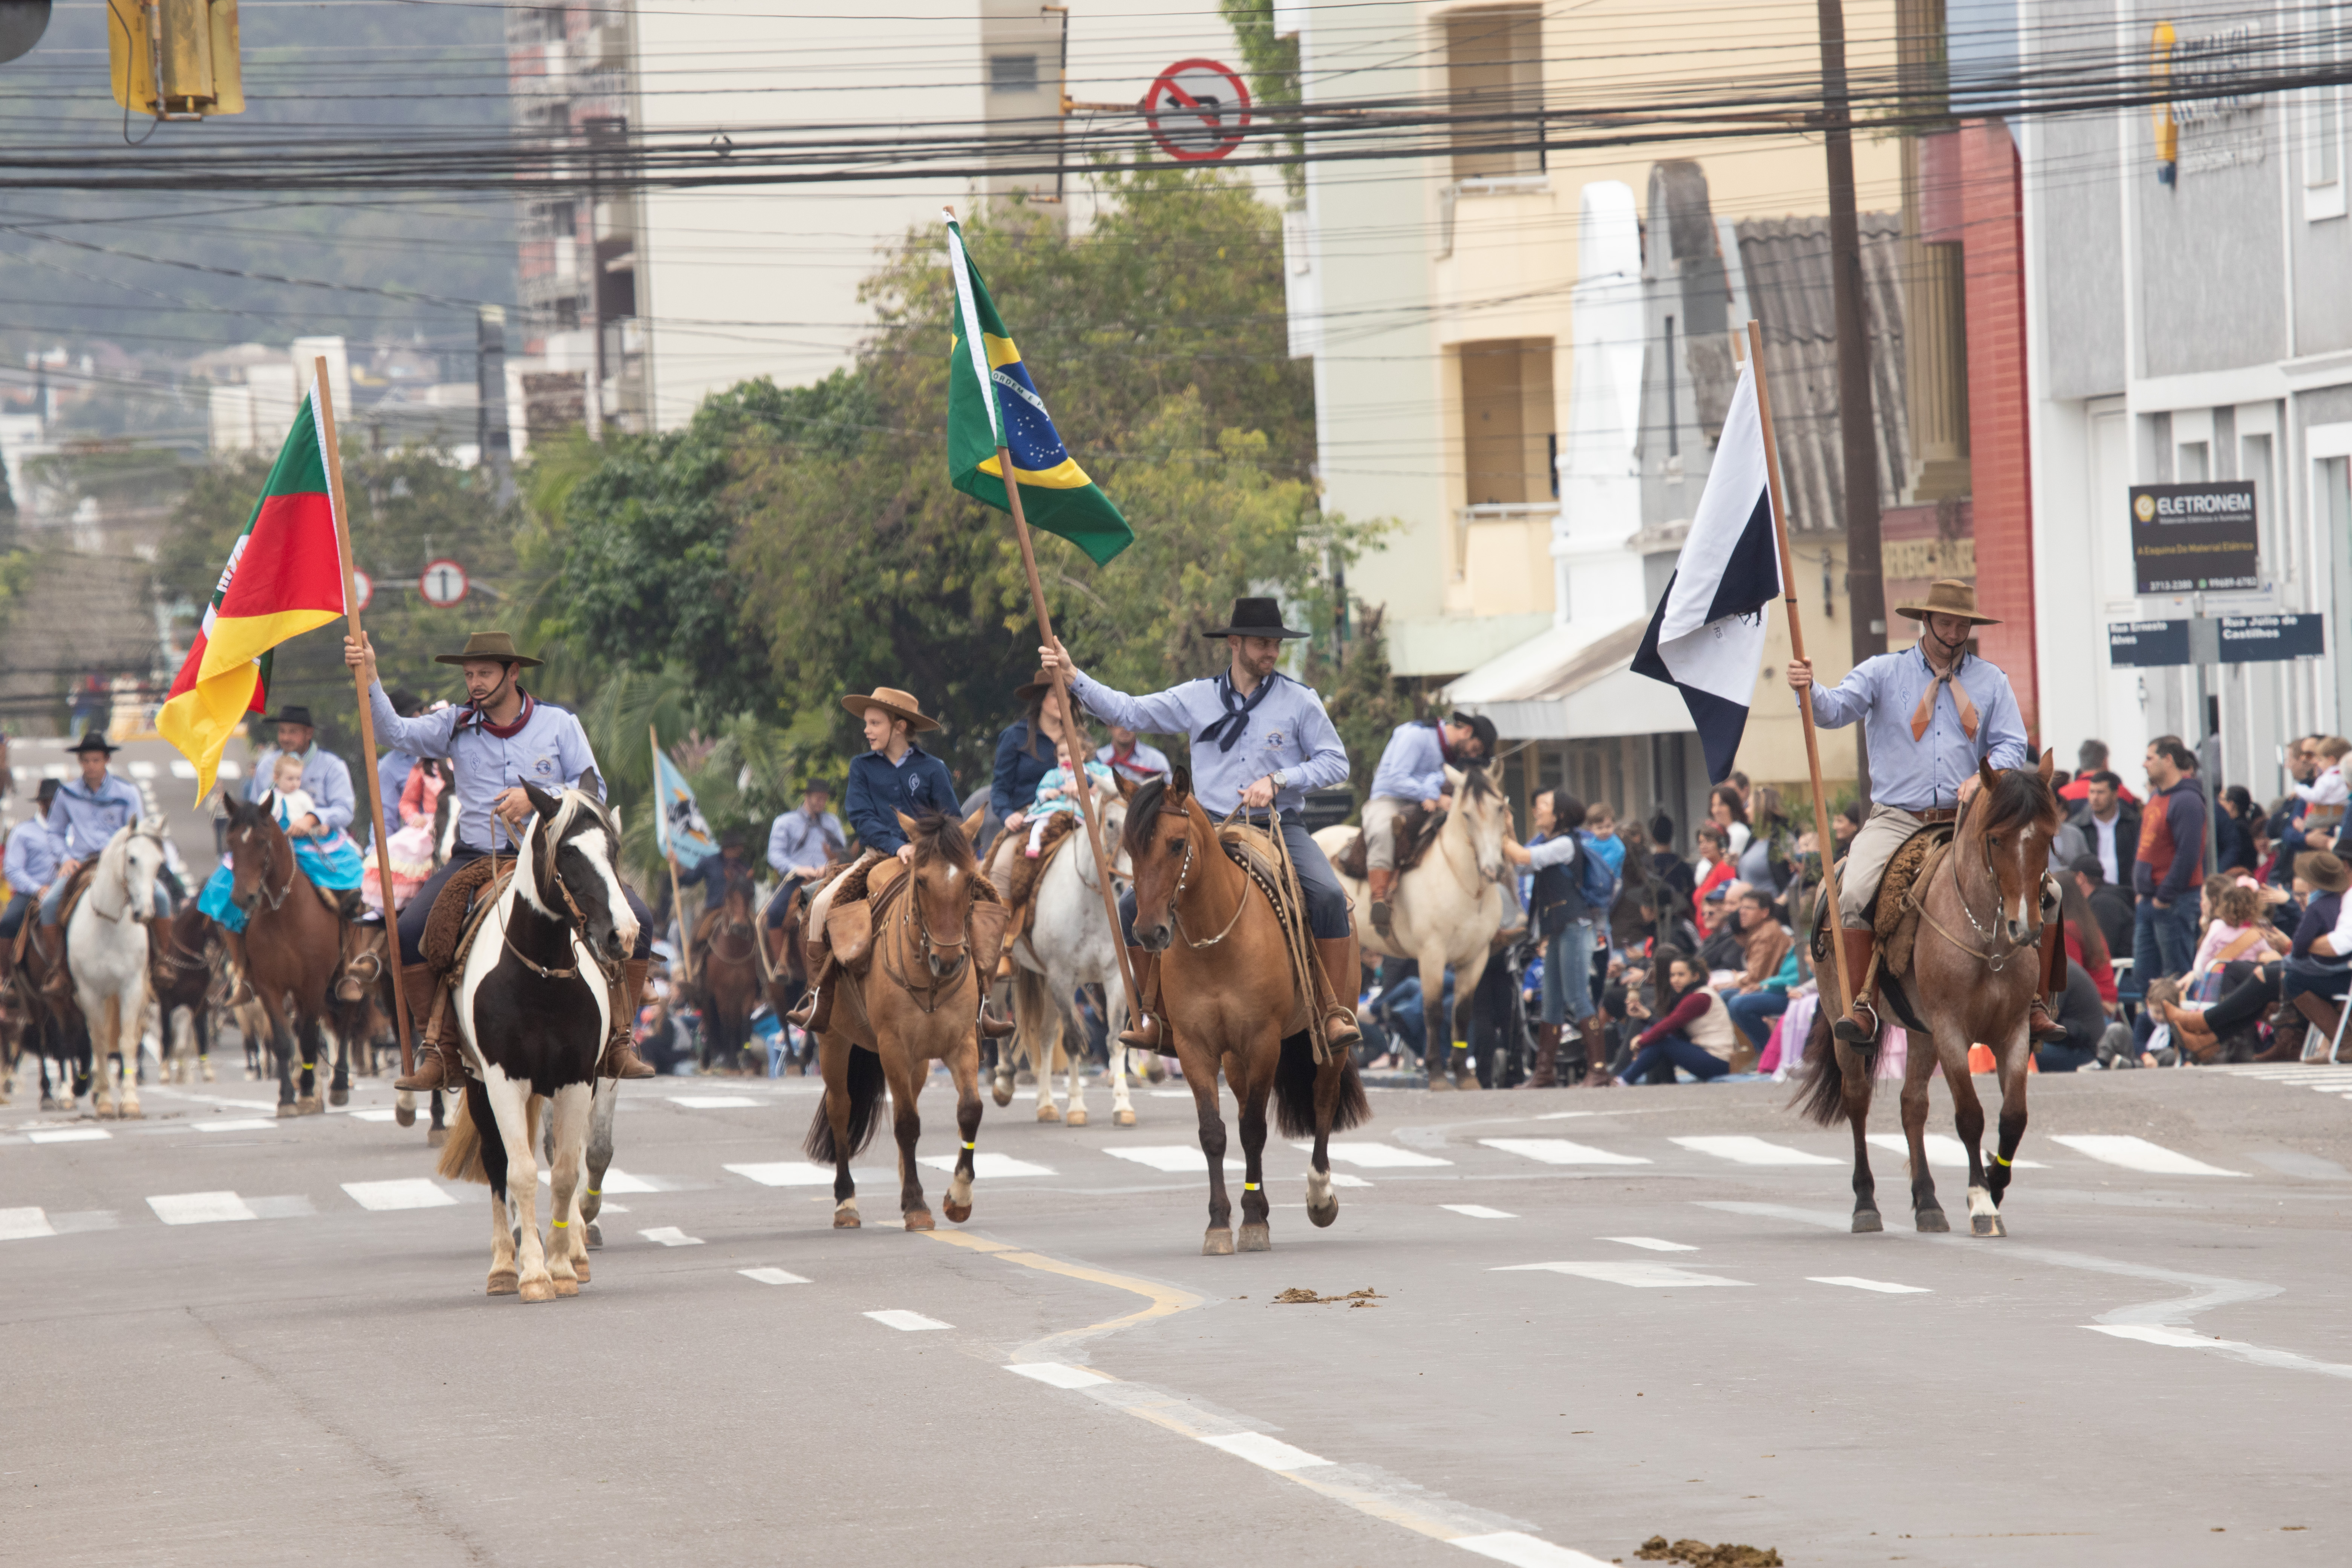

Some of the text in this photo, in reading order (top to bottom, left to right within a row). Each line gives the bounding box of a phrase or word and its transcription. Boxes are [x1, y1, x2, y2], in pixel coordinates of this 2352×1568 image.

[993, 373, 1024, 394] ORDEM
[2157, 493, 2251, 514] ELETRONEM
[2222, 617, 2246, 627] Rua
[2281, 615, 2298, 625] de
[1714, 627, 1723, 639] RS
[2223, 628, 2280, 640] Castilhos
[2111, 635, 2138, 645] Alves
